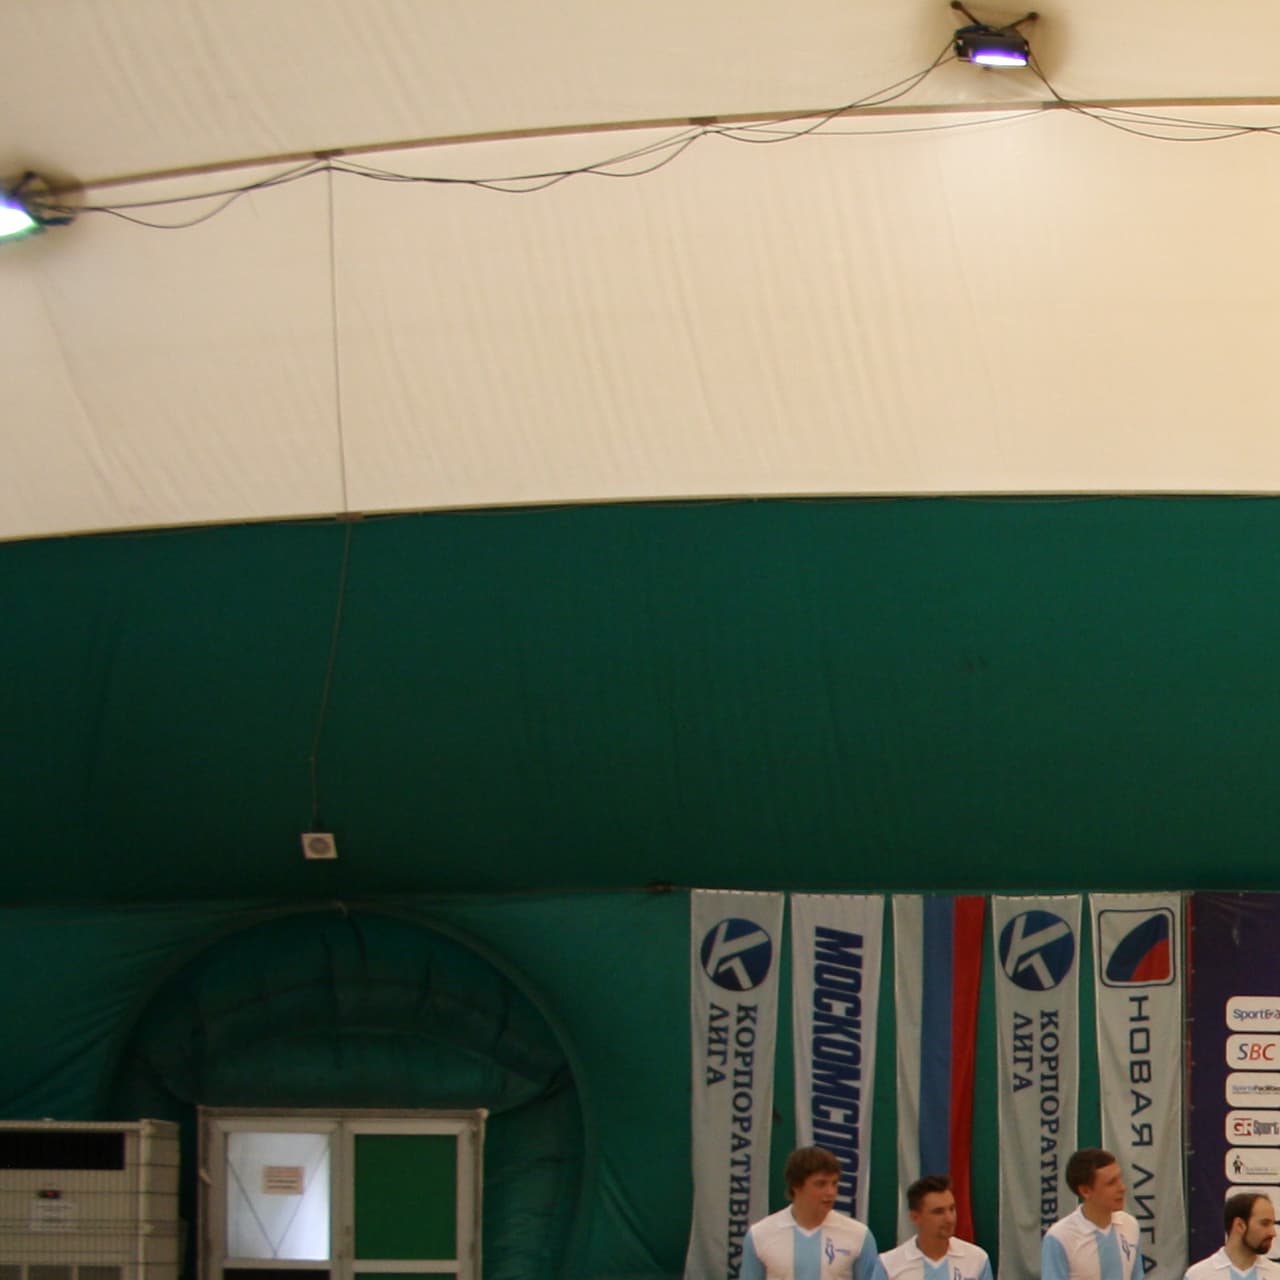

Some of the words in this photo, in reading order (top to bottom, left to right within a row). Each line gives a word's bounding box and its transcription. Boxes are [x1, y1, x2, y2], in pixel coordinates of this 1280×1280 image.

[706, 1003, 729, 1087] ЛИГА
[1013, 1011, 1034, 1093] ЛИГА
[1129, 995, 1153, 1147] НОВАЯ
[1237, 1042, 1275, 1060] SBC
[727, 1003, 758, 1280] КОРПОРАТИВНАЯ
[1040, 1010, 1059, 1239] КОРПОРАТИВ
[1132, 1164, 1157, 1275] ЛИГА
